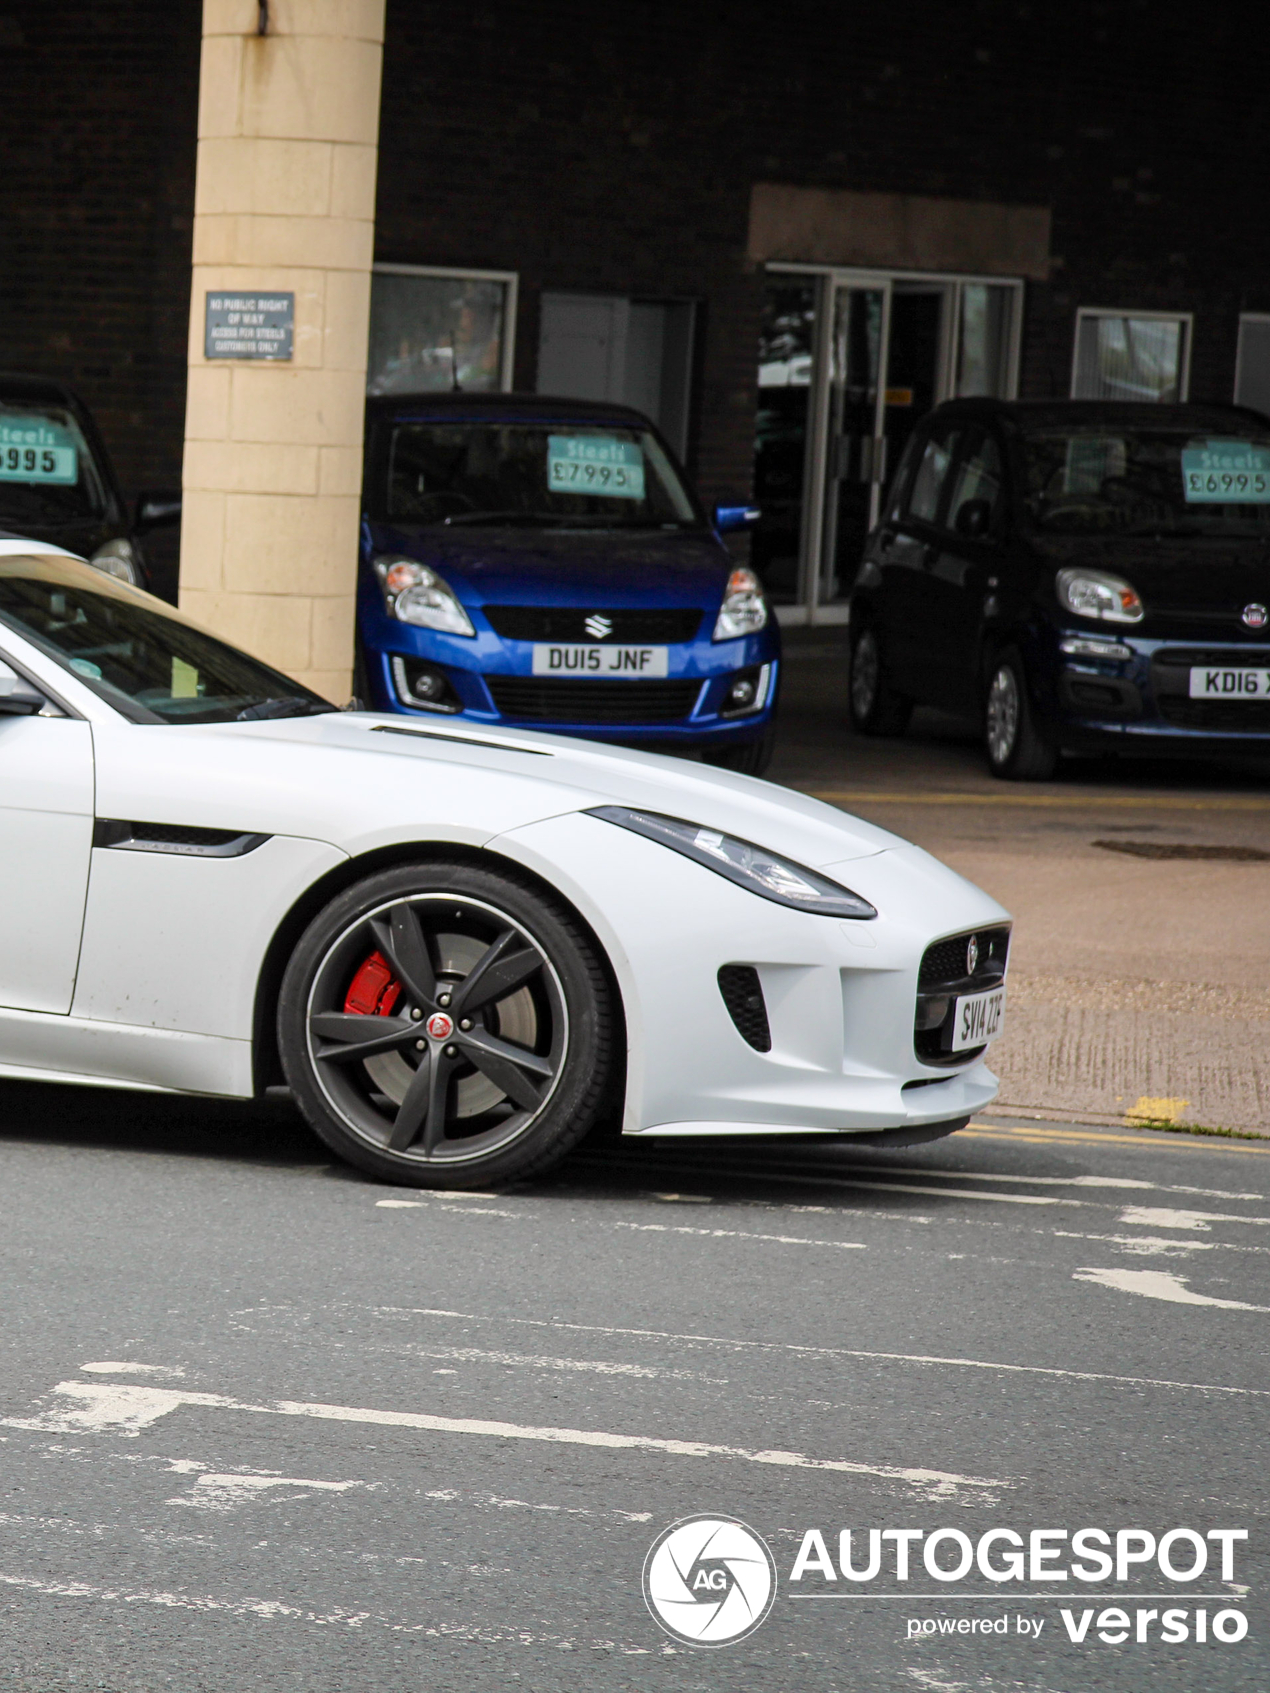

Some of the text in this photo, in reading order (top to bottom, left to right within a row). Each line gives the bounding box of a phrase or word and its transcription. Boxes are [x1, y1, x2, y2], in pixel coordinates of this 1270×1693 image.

[210, 299, 288, 312] NO PUBLIC RIGHT
[227, 312, 265, 325] OF WAY
[211, 327, 285, 340] ACCESS FOR STEELS
[215, 340, 279, 353] CUSTOMERS ONLY
[568, 441, 625, 462] Steels
[1201, 452, 1262, 469] Steels
[553, 462, 626, 487] £7995
[1190, 473, 1266, 493] £6995
[548, 648, 652, 671] DU15 JNF
[1205, 671, 1258, 693] KD16
[961, 998, 986, 1041] SV14
